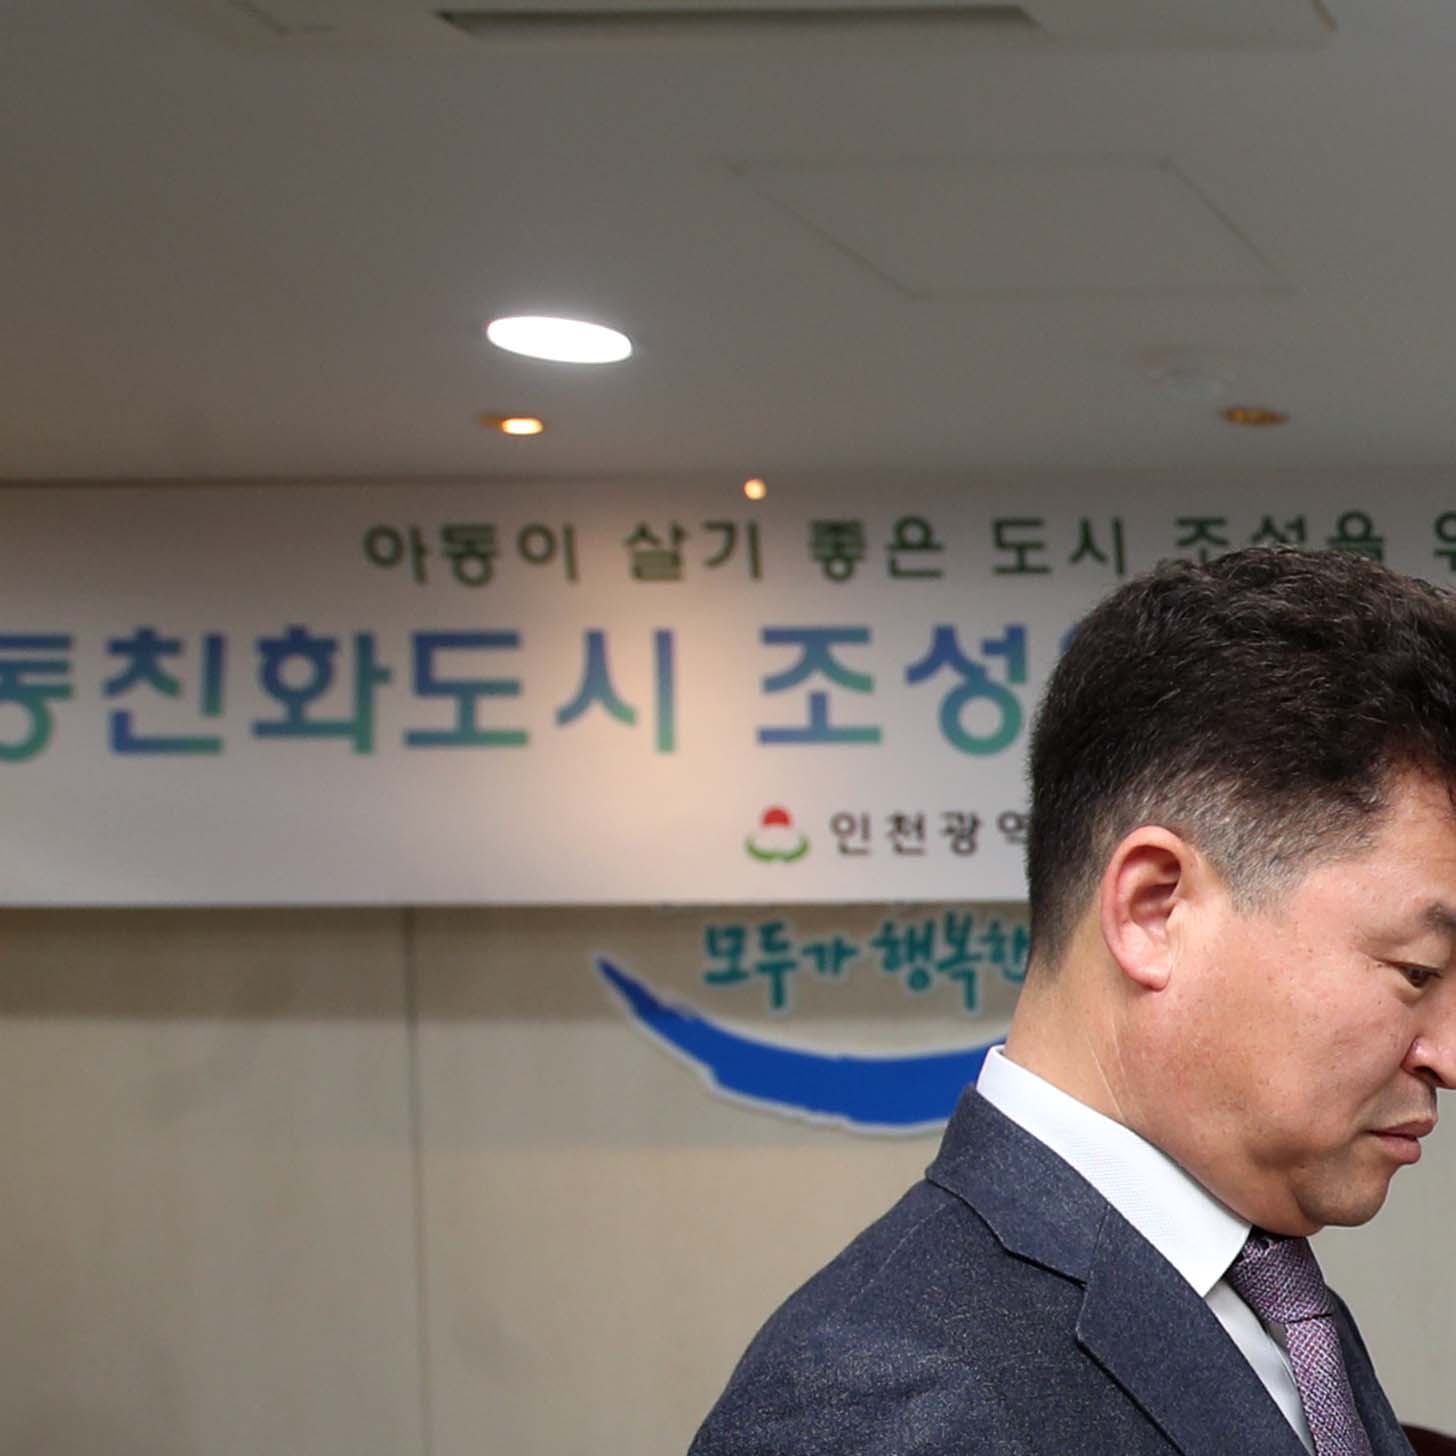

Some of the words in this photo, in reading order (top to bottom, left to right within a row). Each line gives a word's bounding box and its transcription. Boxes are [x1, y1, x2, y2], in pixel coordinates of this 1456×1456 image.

[362, 521, 579, 587] 아동이
[623, 519, 763, 582] 살기
[808, 514, 945, 584] 좋은
[991, 516, 1127, 577] 도시
[0, 624, 680, 764] 동친화도시
[754, 622, 1076, 756] 조성
[703, 920, 860, 1010] 모두가
[869, 910, 1031, 1012] 행복한
